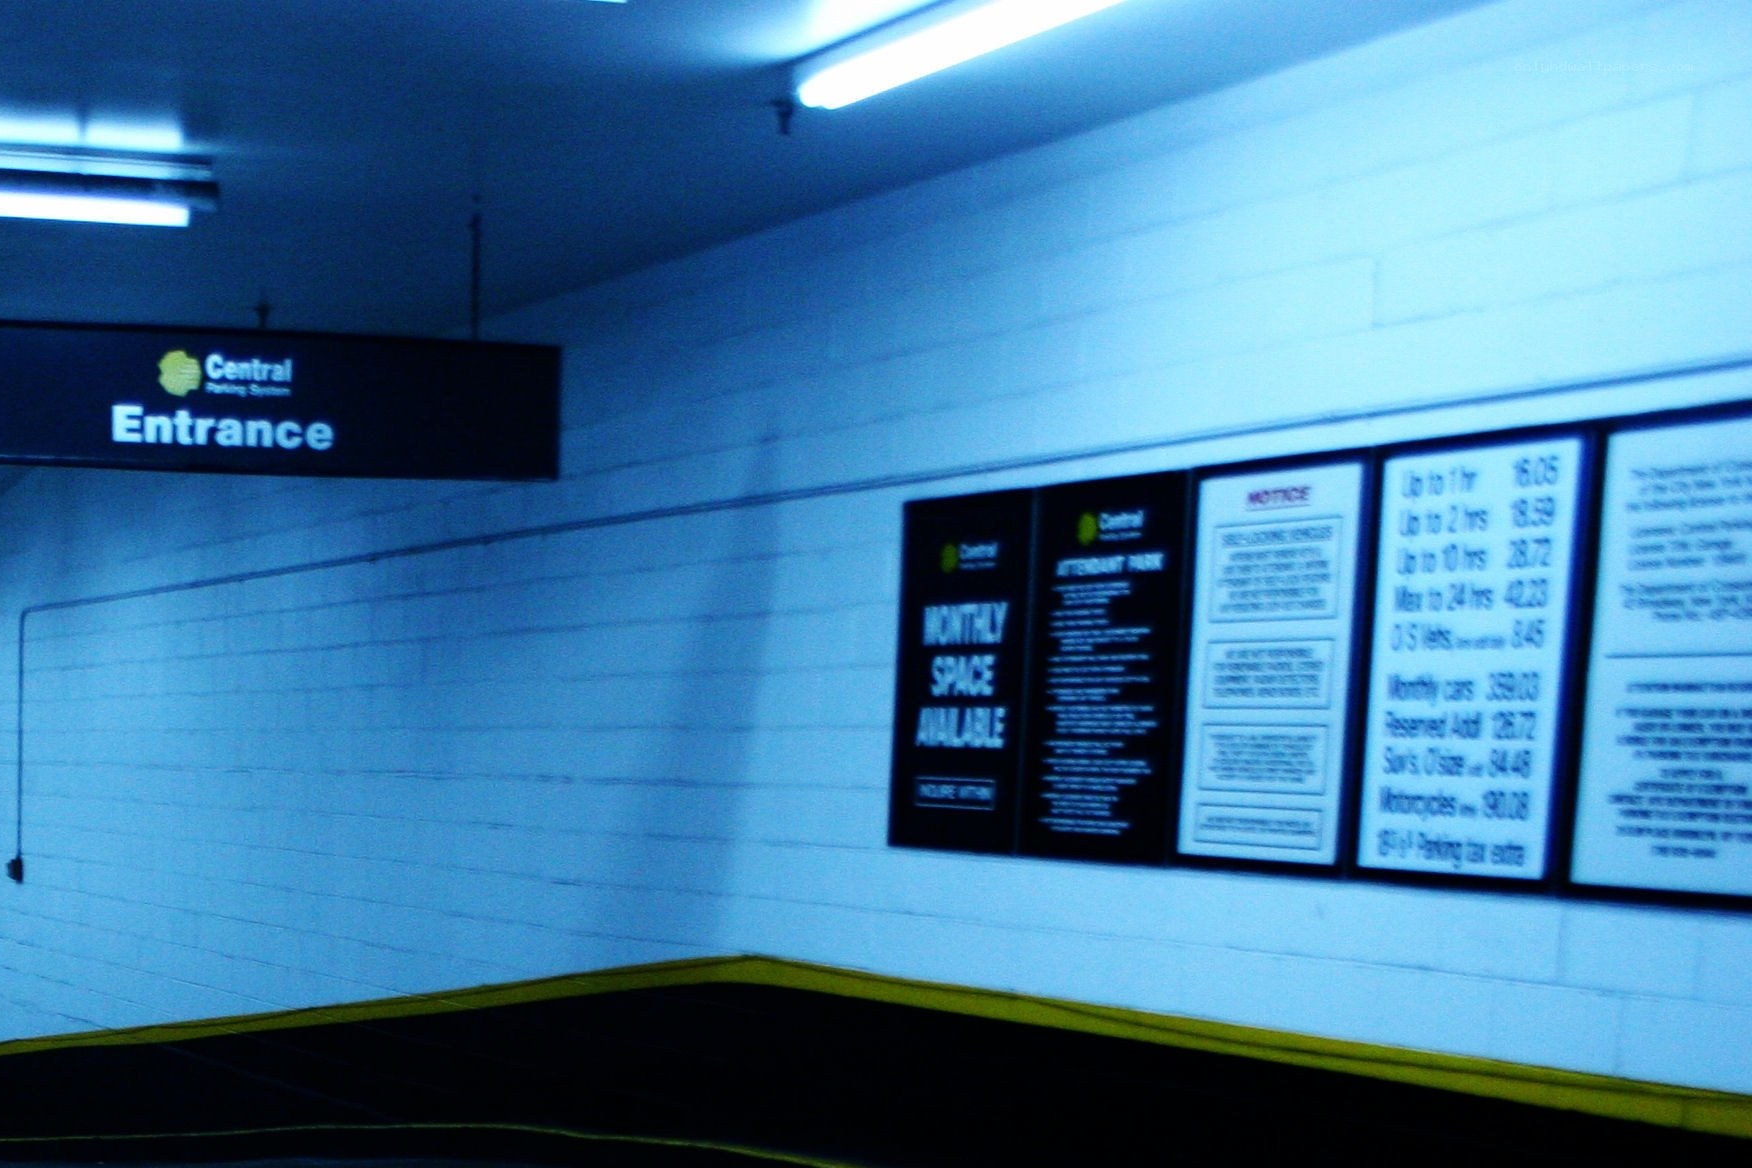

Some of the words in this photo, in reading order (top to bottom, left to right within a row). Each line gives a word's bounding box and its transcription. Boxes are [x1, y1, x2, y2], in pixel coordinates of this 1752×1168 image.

[205, 353, 292, 382] Central
[111, 404, 333, 451] Entrance
[1248, 486, 1312, 506] NOTICE
[1402, 471, 1422, 500] Up
[1399, 509, 1420, 540] Up
[1448, 504, 1458, 533] 2
[1461, 505, 1488, 532] hrs
[1397, 548, 1416, 578] Up
[1462, 544, 1488, 572] hrs
[1469, 582, 1494, 611] hrs
[923, 602, 1008, 646] MONTHLY
[930, 654, 996, 696] SPACE
[1387, 672, 1439, 706] Monthly
[916, 707, 1006, 748] AVAILABLE
